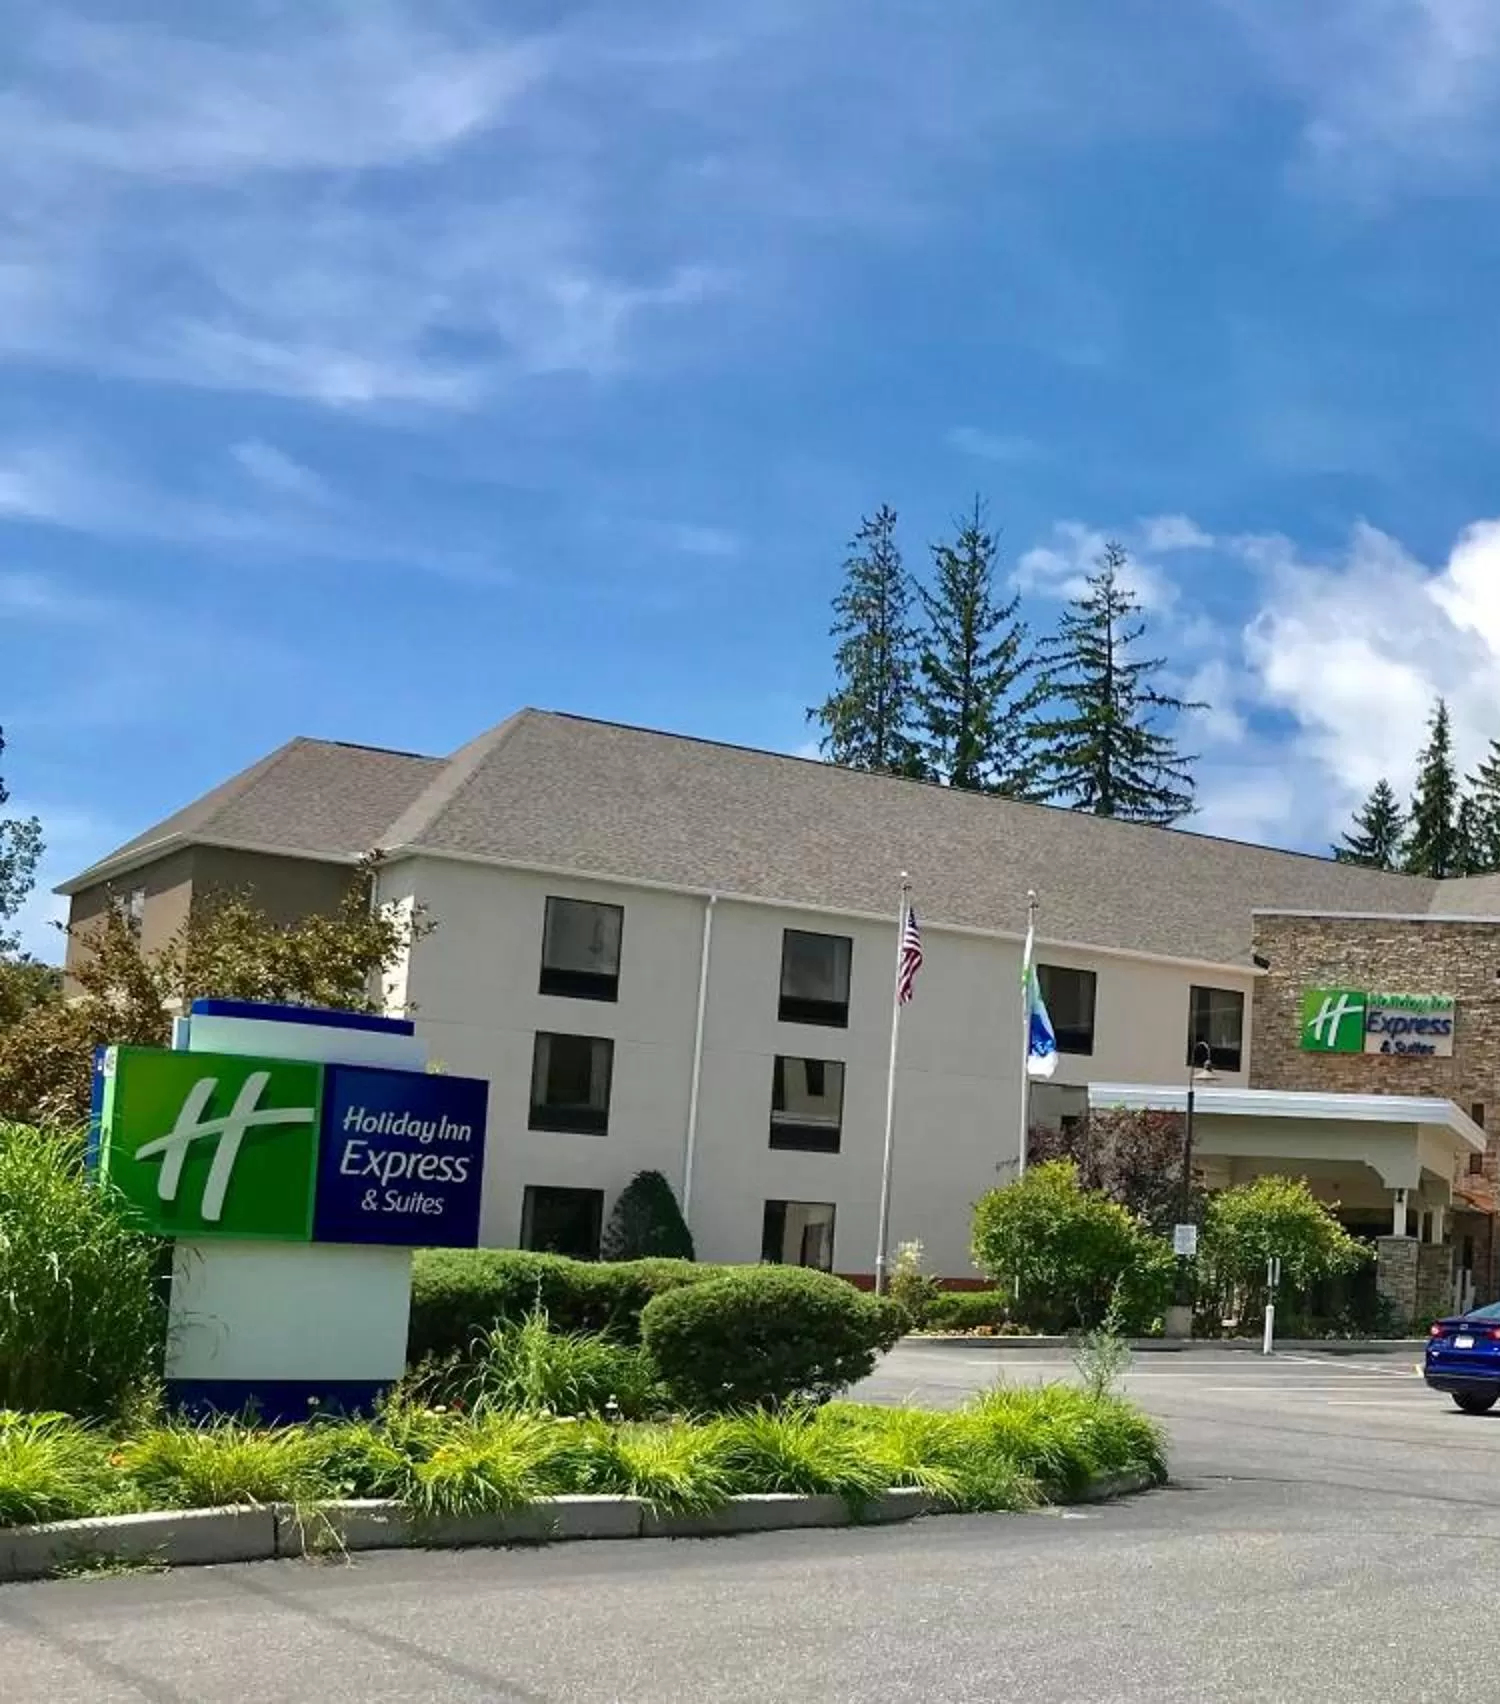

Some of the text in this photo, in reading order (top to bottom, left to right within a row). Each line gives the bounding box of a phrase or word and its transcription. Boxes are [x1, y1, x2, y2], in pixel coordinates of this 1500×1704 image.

[1369, 994, 1453, 1014] Holiday Inn
[1367, 1011, 1453, 1039] Express
[1394, 1040, 1437, 1054] Suites
[342, 1105, 472, 1144] Holiday Inn
[340, 1139, 470, 1187] Express
[361, 1188, 445, 1215] & Suites
